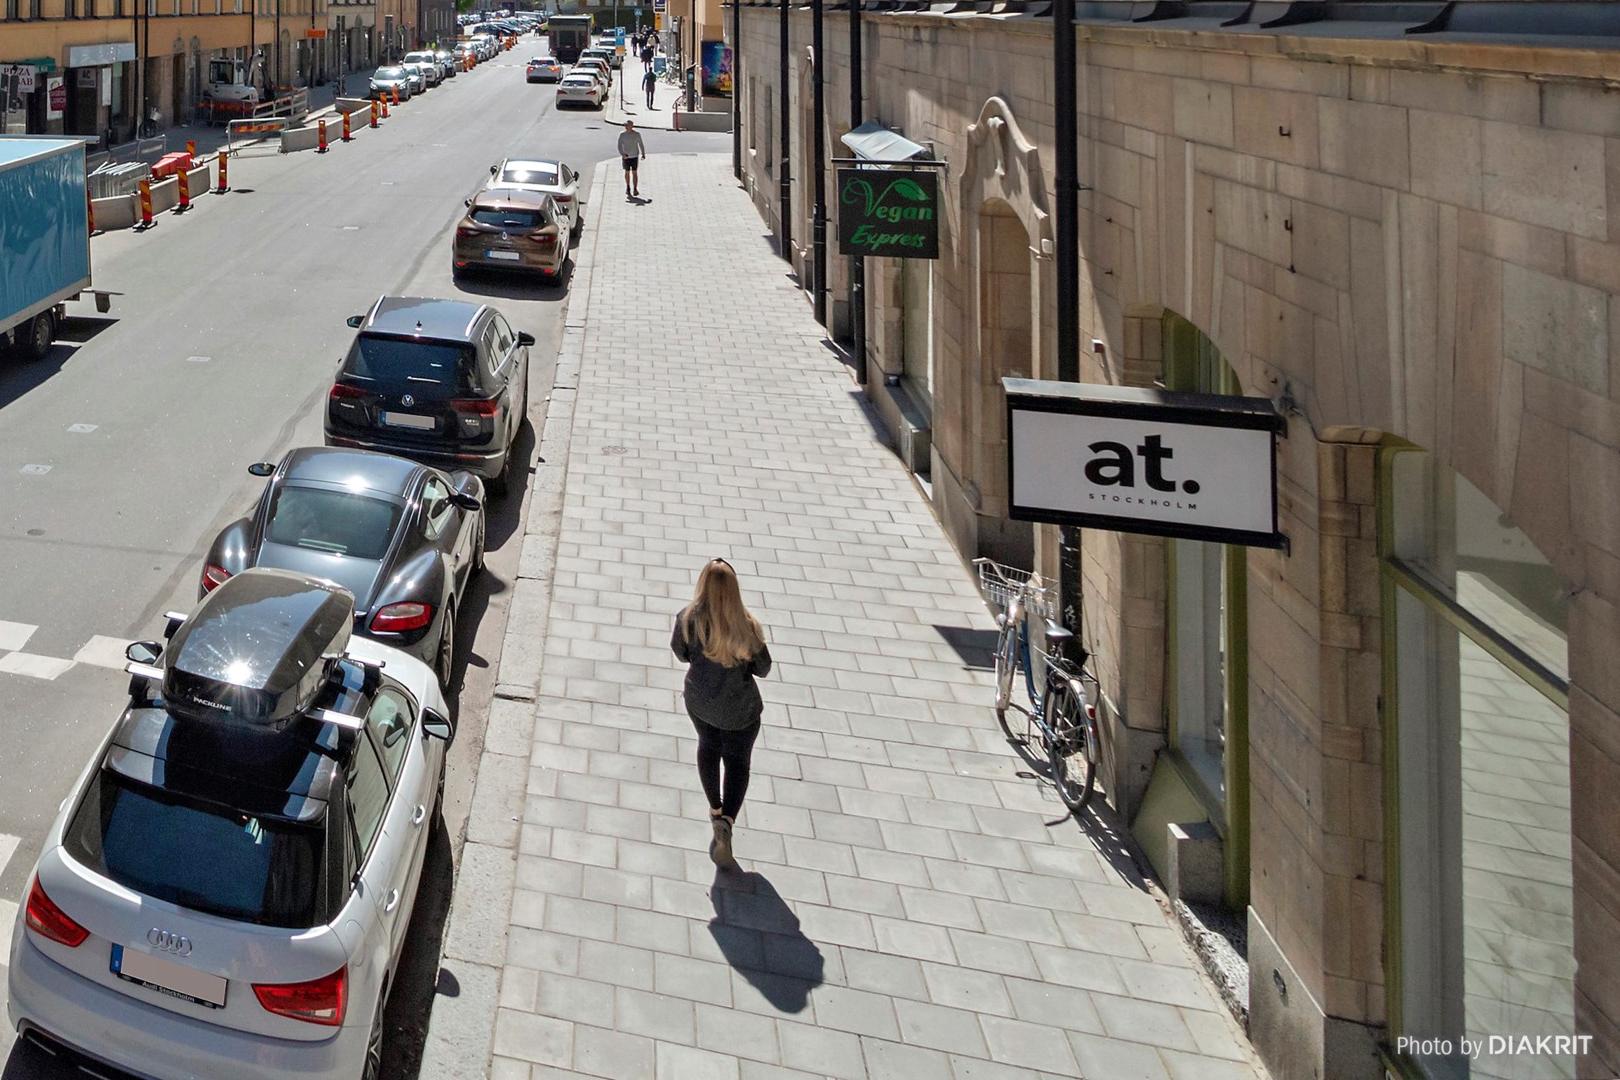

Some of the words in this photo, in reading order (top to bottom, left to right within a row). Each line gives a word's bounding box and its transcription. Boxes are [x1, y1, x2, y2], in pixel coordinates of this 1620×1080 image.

[4, 67, 31, 76] PIZZA
[842, 177, 932, 223] Vegan
[850, 224, 927, 251] Express
[1084, 434, 1201, 495] at.
[1088, 493, 1198, 510] STOCKHOLM
[193, 696, 232, 712] PACKLINE
[142, 981, 158, 991] Audi
[159, 987, 195, 1003] Stockholm
